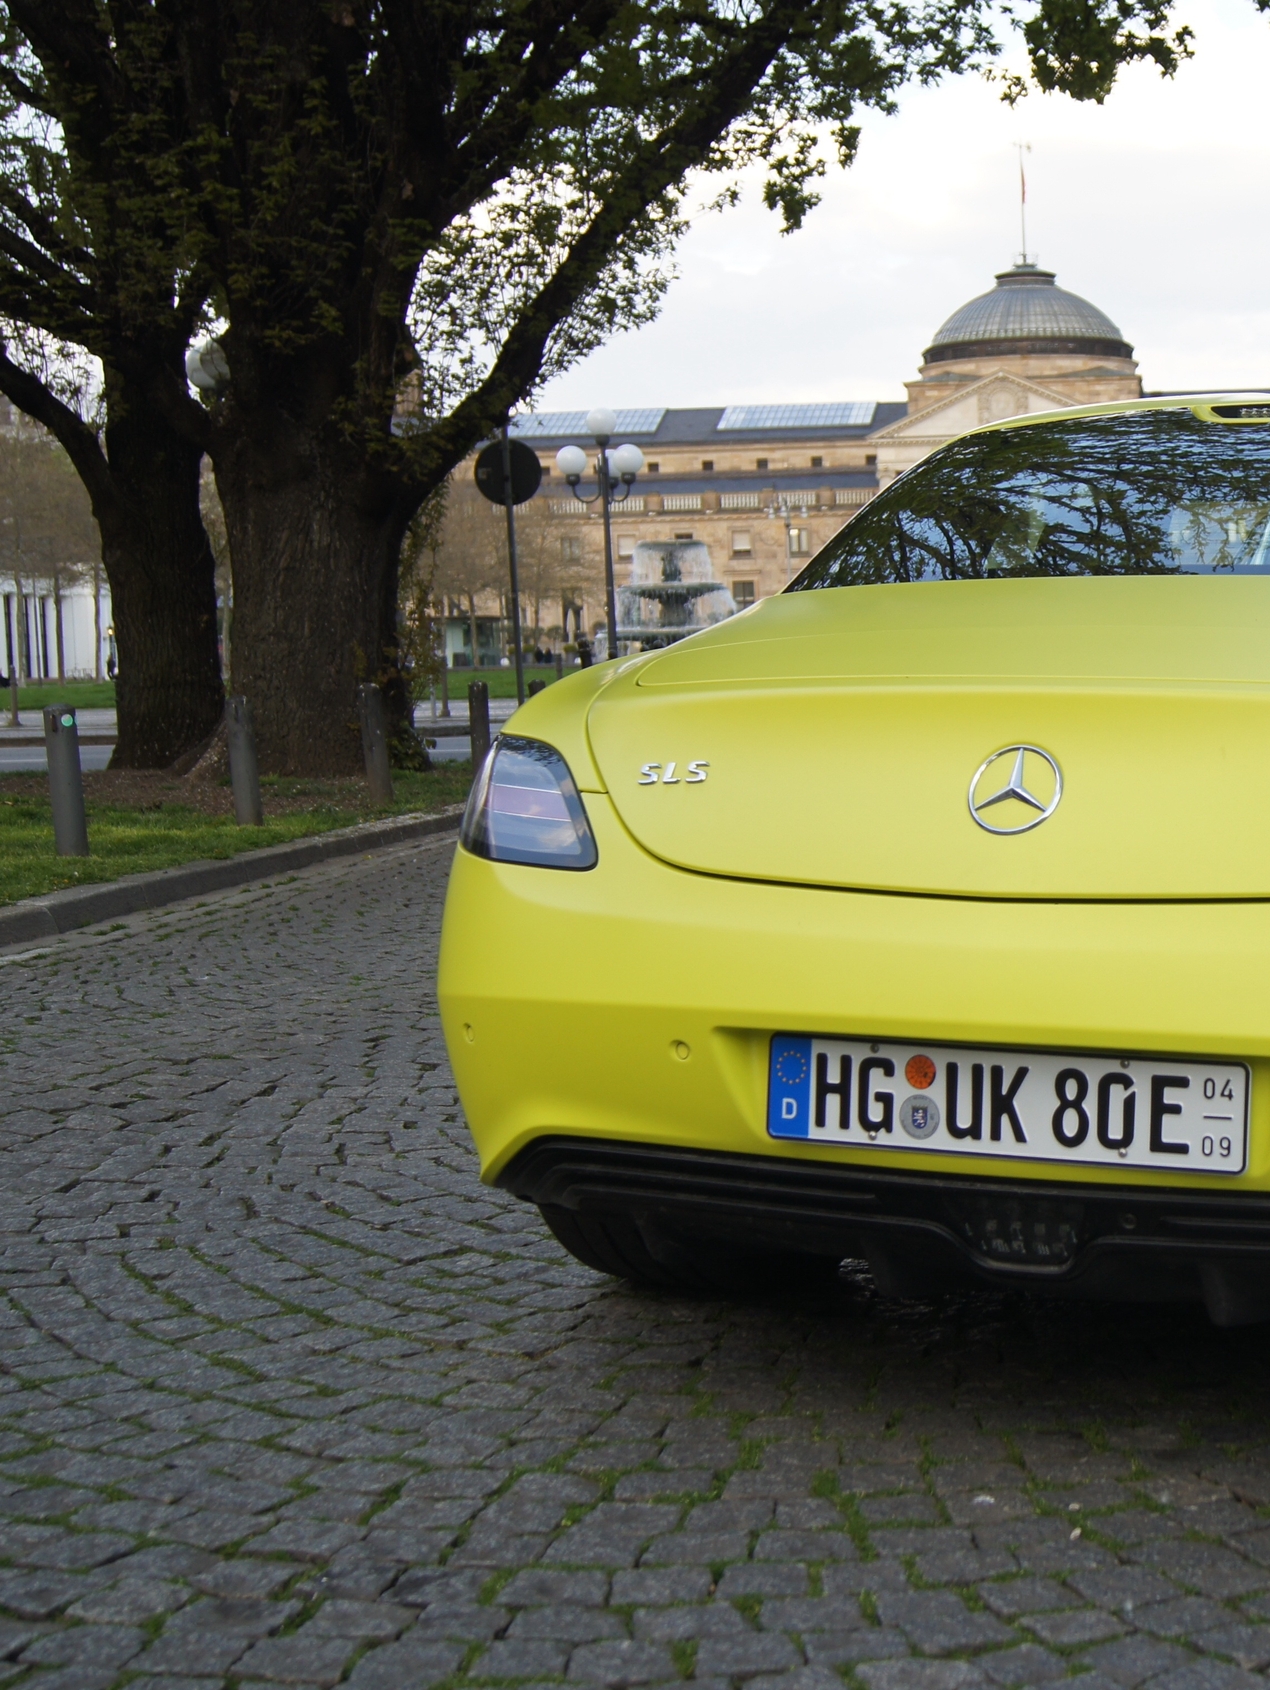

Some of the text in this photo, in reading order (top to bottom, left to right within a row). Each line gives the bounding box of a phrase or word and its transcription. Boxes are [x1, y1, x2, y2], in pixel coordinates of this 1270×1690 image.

[637, 761, 710, 785] SLS
[1203, 1077, 1234, 1101] 04
[781, 1097, 798, 1119] D
[815, 1052, 896, 1134] HG
[945, 1061, 1031, 1144] UK
[1051, 1067, 1191, 1155] 80E
[1201, 1135, 1231, 1158] 09
